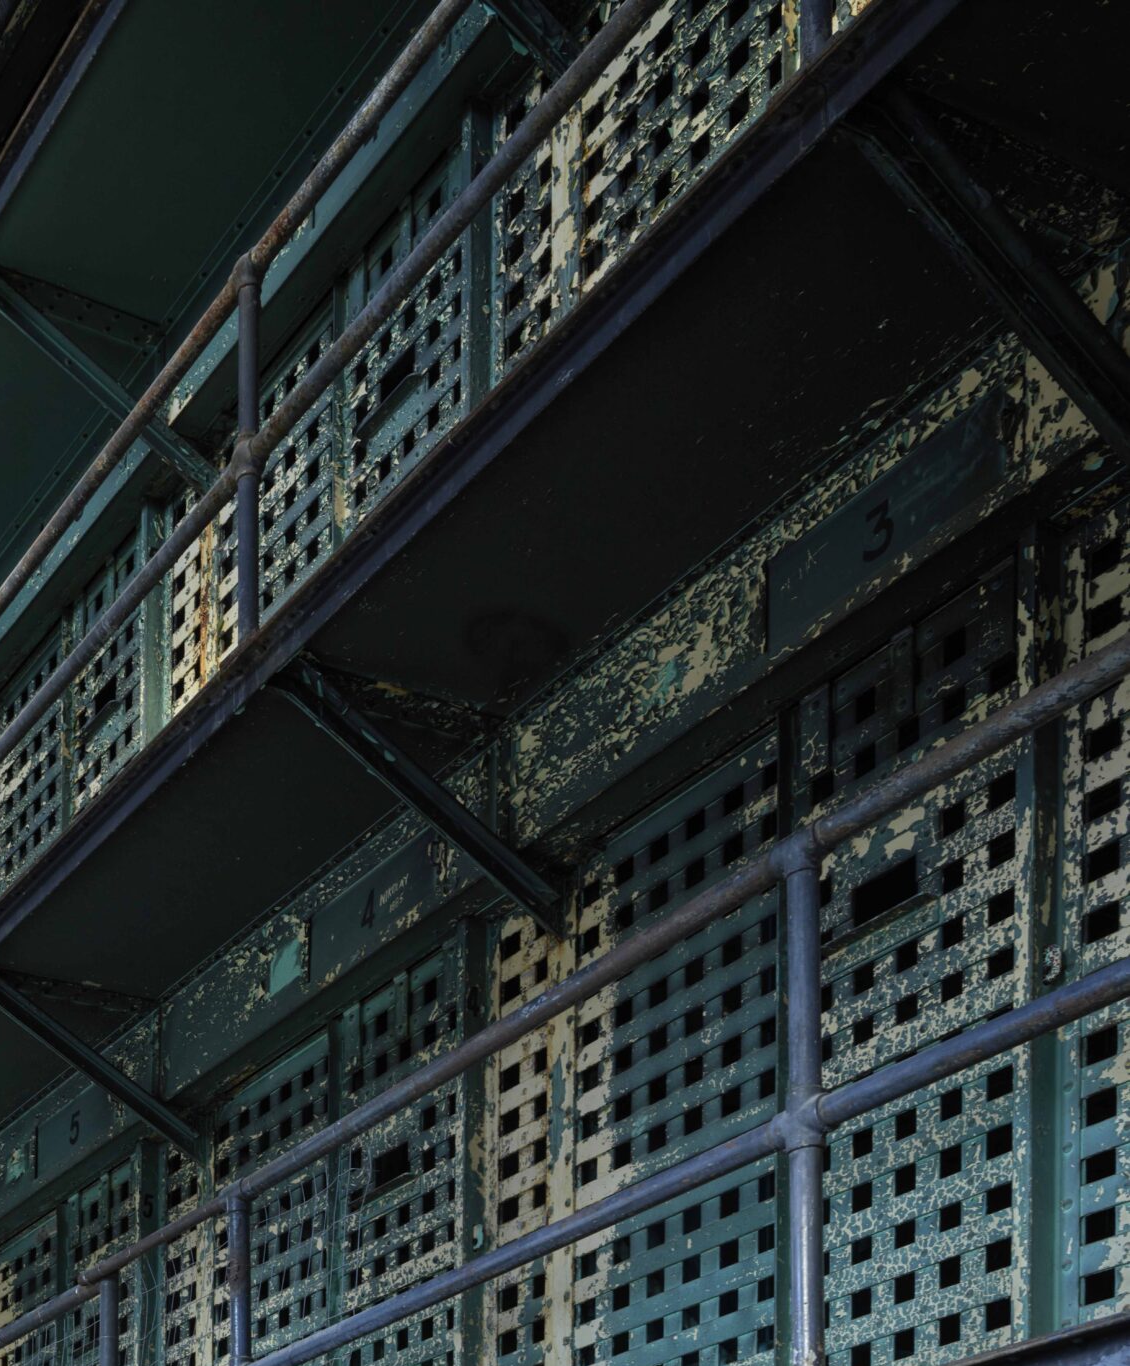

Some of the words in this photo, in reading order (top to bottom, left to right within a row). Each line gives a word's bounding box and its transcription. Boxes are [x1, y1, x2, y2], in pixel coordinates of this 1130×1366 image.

[862, 499, 895, 563] 3
[360, 887, 375, 929] 4
[69, 1109, 81, 1145] 5
[142, 1193, 154, 1218] 5
